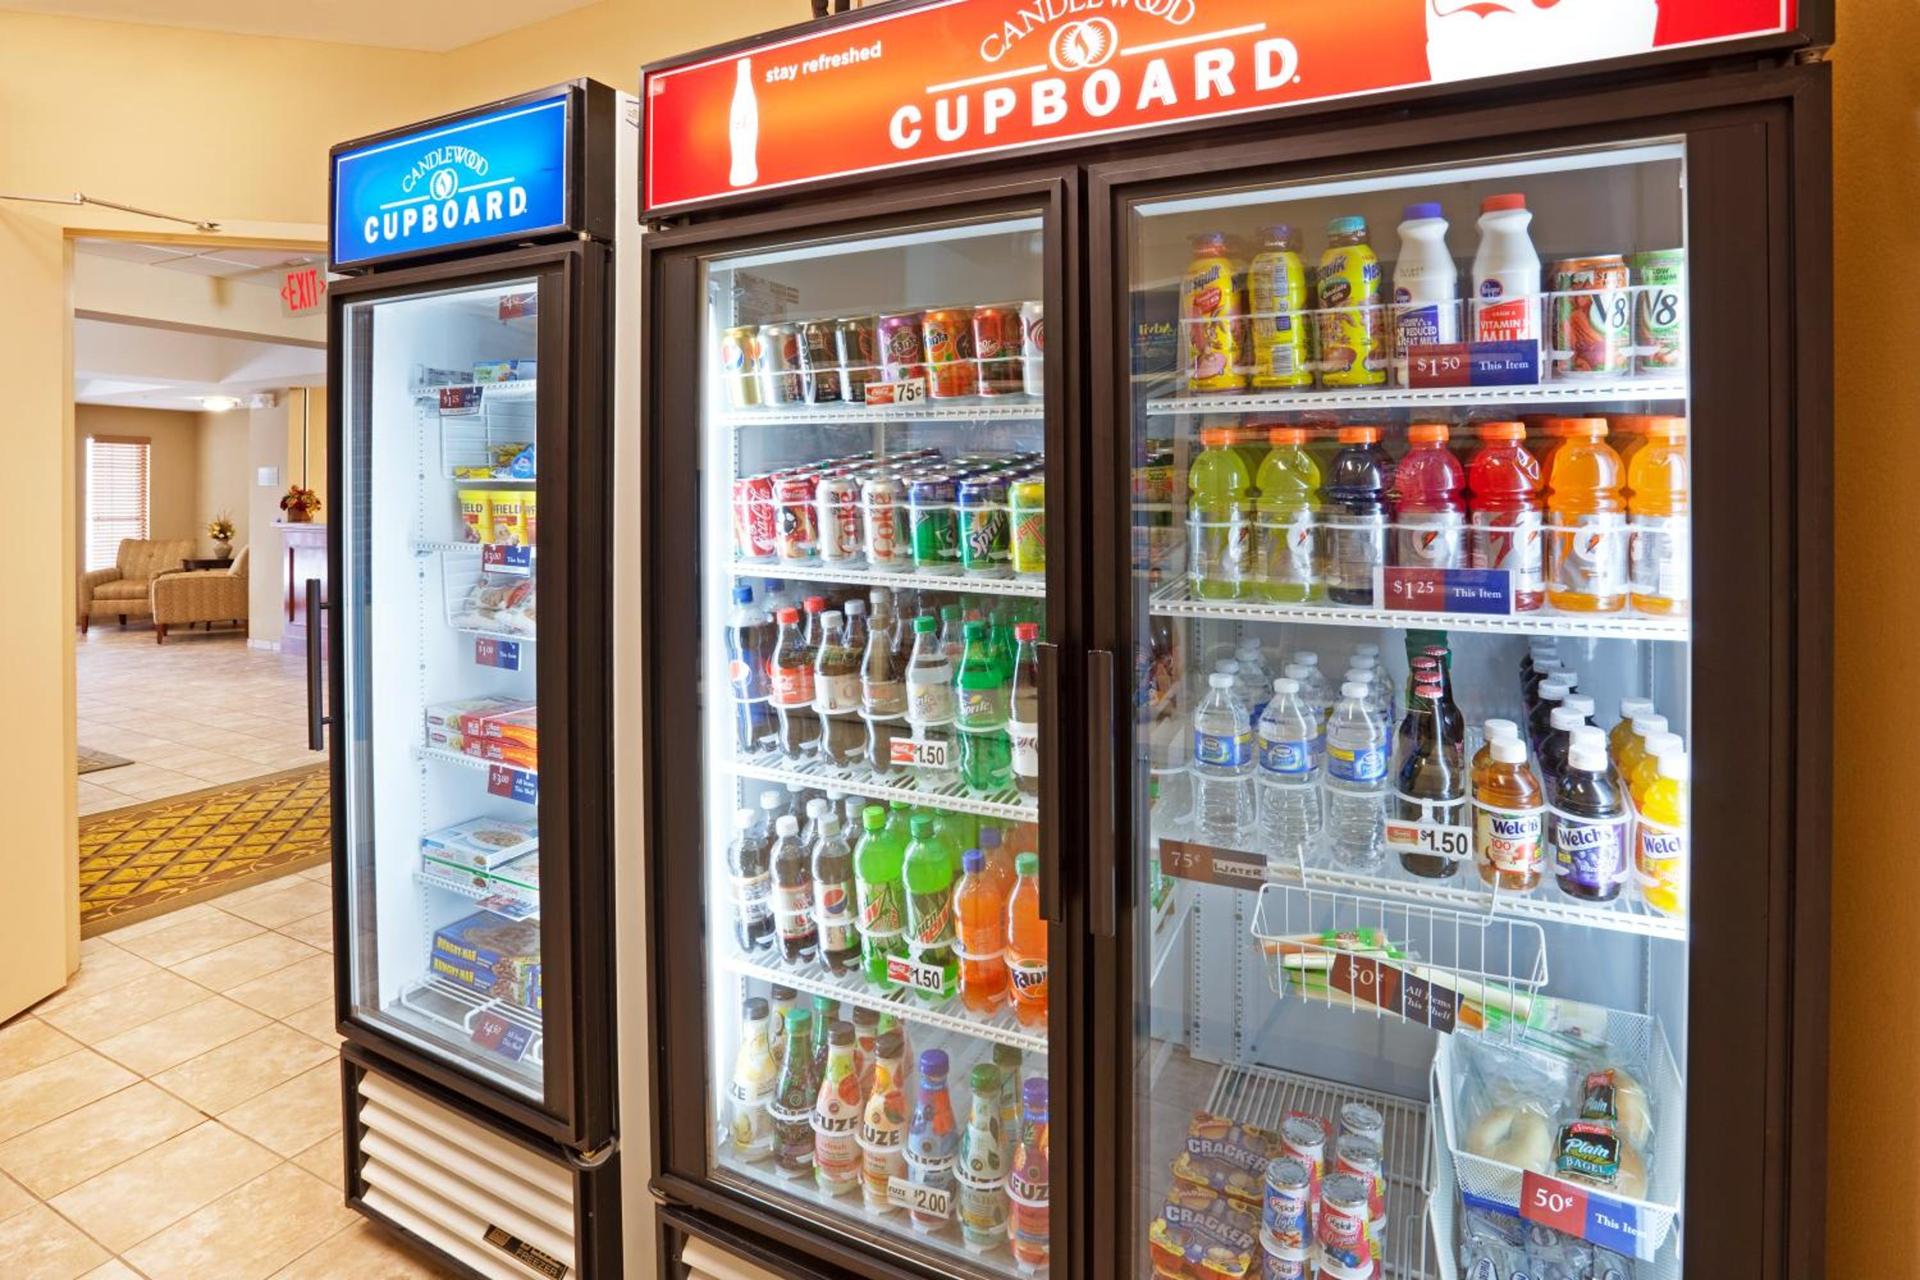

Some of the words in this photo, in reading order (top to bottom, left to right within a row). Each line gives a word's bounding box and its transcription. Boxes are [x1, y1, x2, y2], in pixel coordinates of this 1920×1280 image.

[765, 65, 798, 84] stay
[801, 41, 882, 73] refreshed
[402, 145, 490, 193] CANDLEWOOD
[287, 268, 317, 311] EXIT
[1645, 289, 1678, 326] V8
[1479, 360, 1502, 371] This
[1506, 360, 1529, 370] Item
[1454, 587, 1476, 599] This
[1479, 589, 1502, 600] Item
[1420, 829, 1468, 855] $1.50
[1214, 860, 1262, 877] WATER
[1566, 1138, 1610, 1158] Plain
[1165, 1205, 1254, 1250] CRACKER
[1533, 1188, 1574, 1213] 50¢
[1595, 1212, 1620, 1230] This
